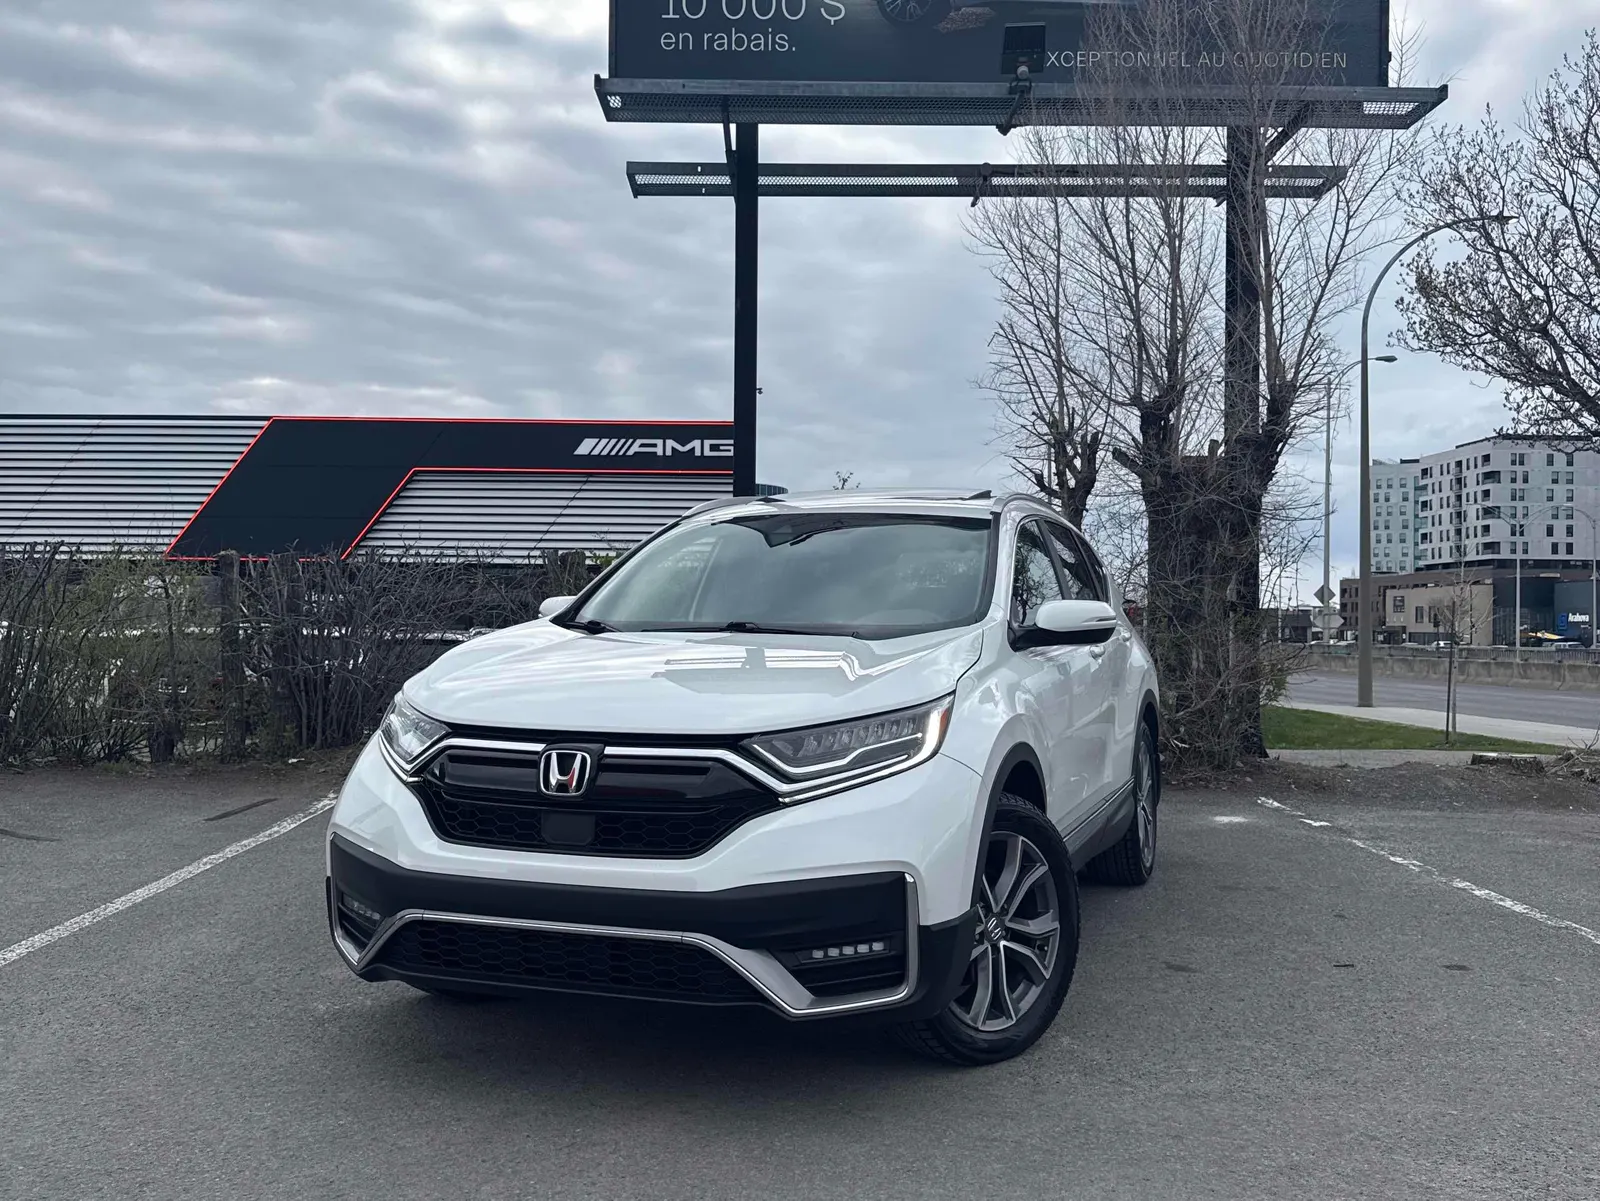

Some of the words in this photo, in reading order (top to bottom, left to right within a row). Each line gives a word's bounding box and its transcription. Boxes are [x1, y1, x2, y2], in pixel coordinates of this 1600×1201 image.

[660, 32, 693, 50] en
[703, 28, 796, 51] rabais.
[1043, 51, 1191, 67] XCEPTIONNEL
[1197, 51, 1226, 68] AU
[1233, 51, 1347, 68] QUOTIDIEN
[626, 438, 734, 457] AMG
